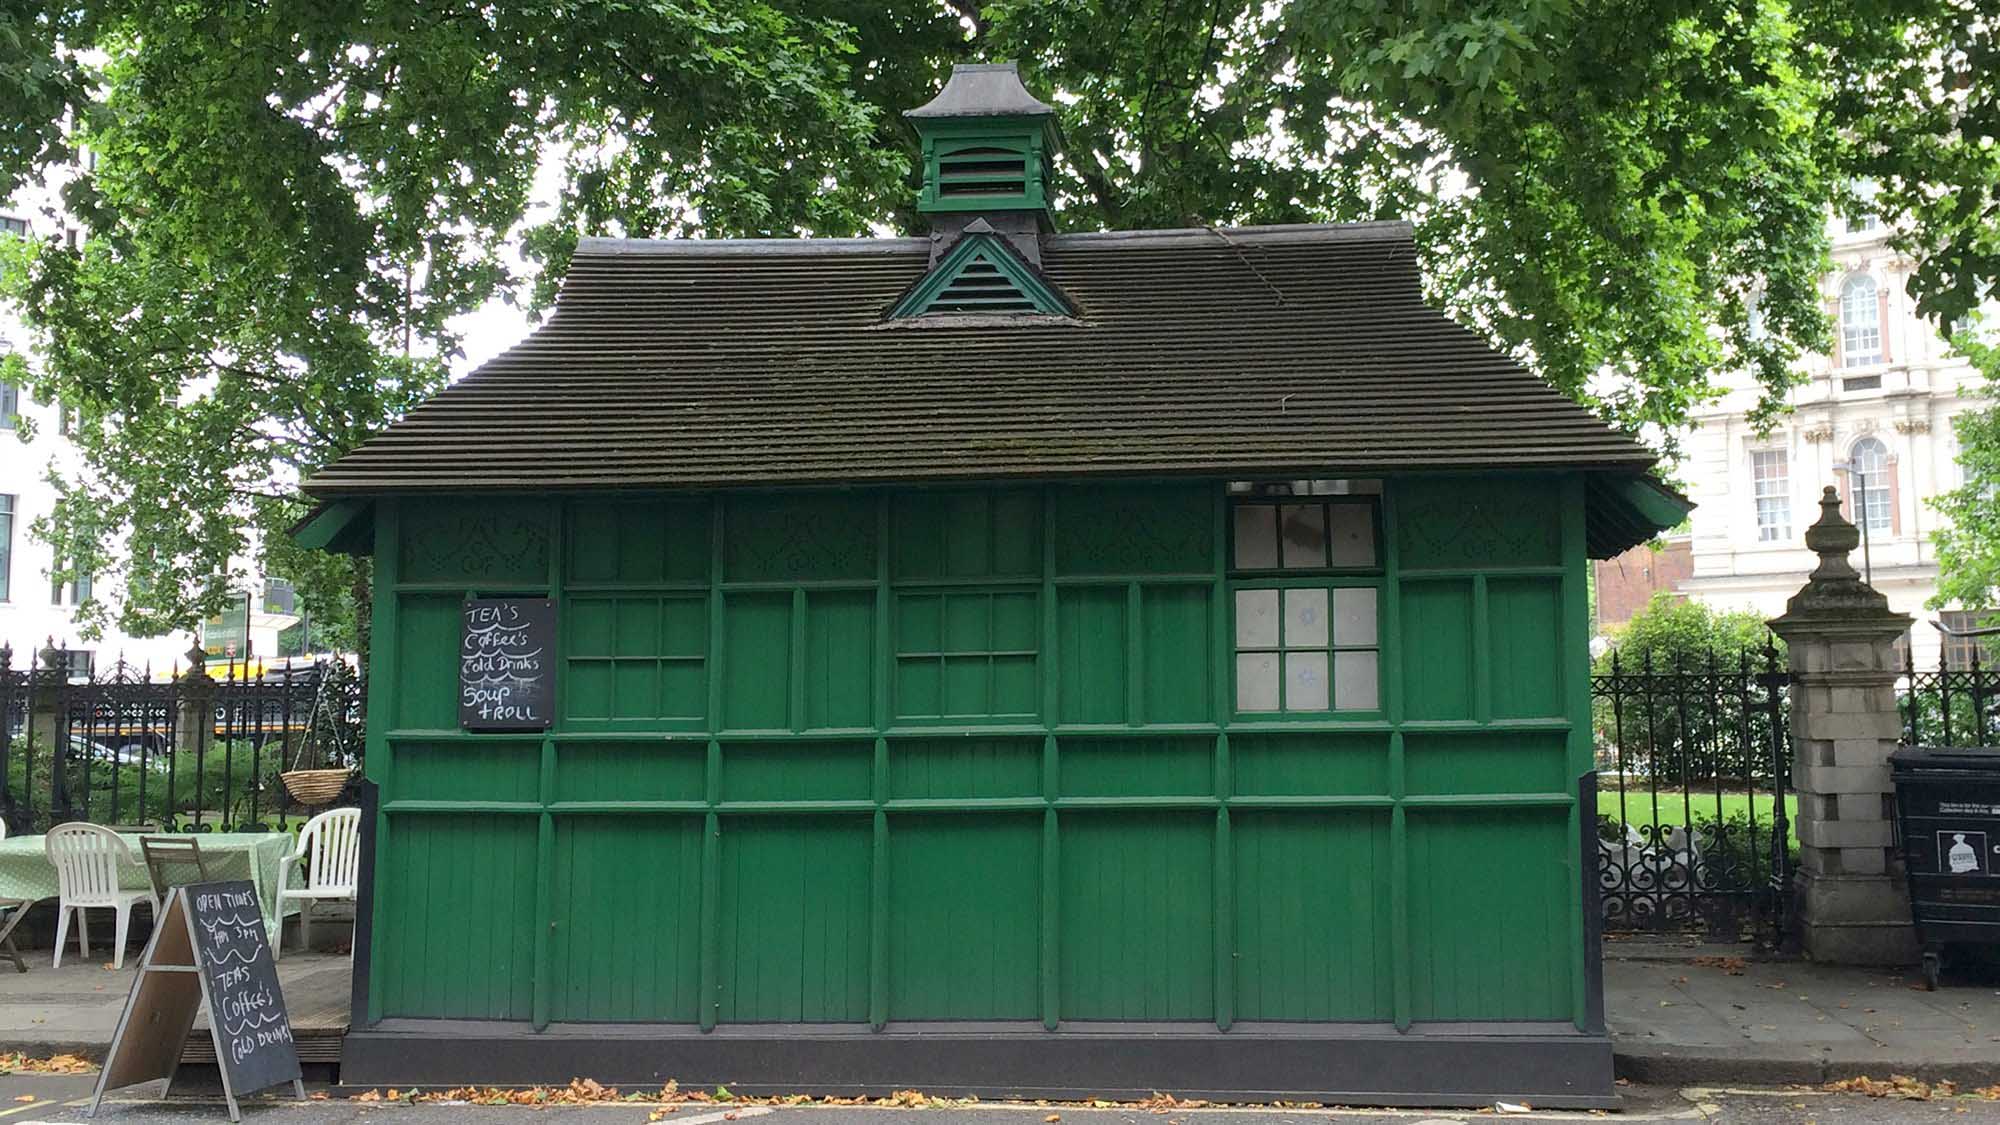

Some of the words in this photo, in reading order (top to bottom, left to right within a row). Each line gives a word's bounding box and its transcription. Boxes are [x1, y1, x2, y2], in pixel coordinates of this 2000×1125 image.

[465, 603, 519, 623] TEA'S
[462, 657, 495, 674] Cold
[497, 656, 539, 672] Drinks
[463, 685, 511, 708] Soup
[196, 893, 222, 913] OPEN
[215, 966, 250, 992] TEAS
